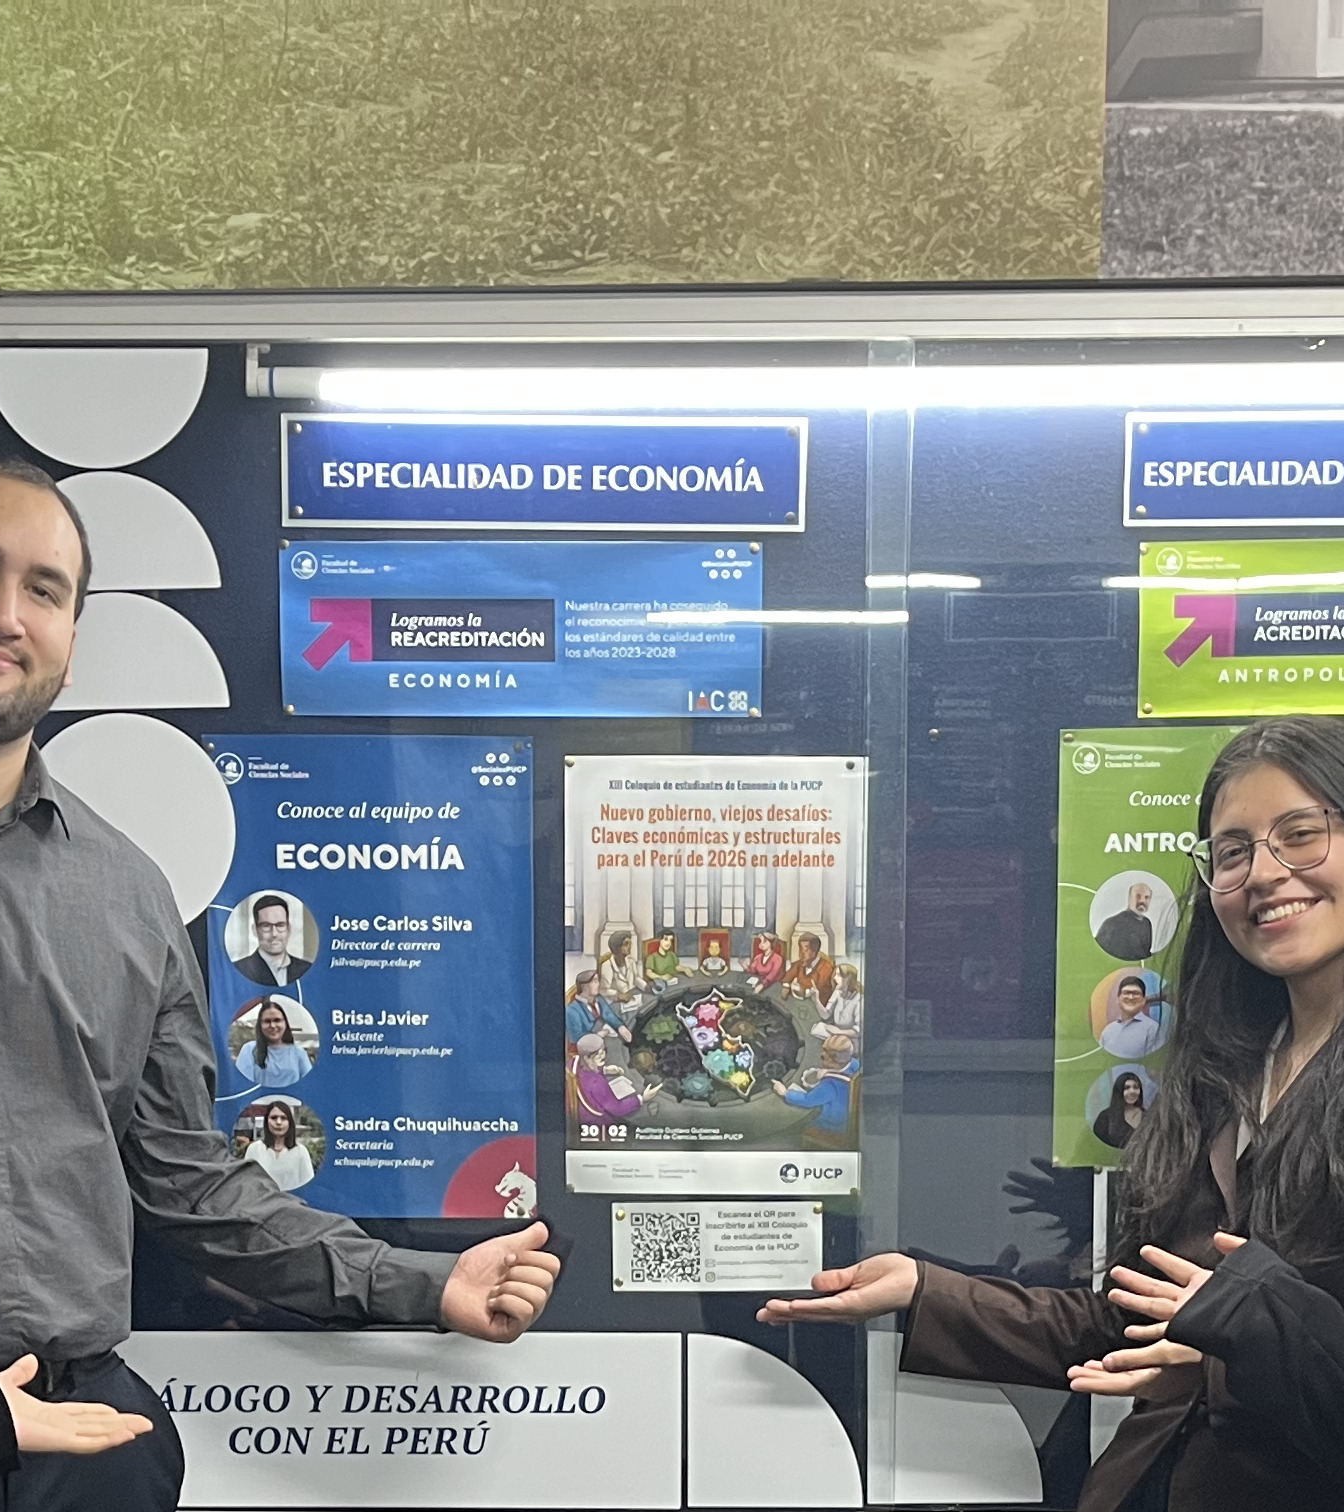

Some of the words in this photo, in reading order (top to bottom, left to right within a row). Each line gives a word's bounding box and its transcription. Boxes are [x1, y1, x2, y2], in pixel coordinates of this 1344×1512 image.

[322, 462, 534, 489] ESPECIALIDAD
[544, 465, 582, 490] DE
[592, 458, 765, 493] ECONOMÍA
[1143, 460, 1344, 486] ESPECIALIDAD
[565, 600, 610, 611] Nuestra
[612, 602, 652, 611] carrera
[654, 600, 668, 611] ha
[1255, 606, 1328, 622] Logramos
[391, 613, 464, 630] Logramos
[467, 613, 482, 627] la
[391, 628, 545, 647] REACREDITACIÓN
[565, 631, 581, 642] los
[583, 631, 644, 642] estándares
[646, 631, 660, 642] de
[663, 631, 703, 642] calidad
[706, 632, 736, 642] entre
[565, 647, 581, 658] los
[583, 647, 609, 658] años
[388, 670, 517, 688] ECONOMÍA
[1129, 791, 1191, 806] Conoce
[277, 801, 344, 819] Conoce
[349, 802, 366, 819] al
[371, 802, 433, 823] equipo
[438, 802, 461, 819] de
[600, 804, 644, 821] Nuevo
[648, 804, 716, 824] gobierno,
[720, 804, 763, 824] viejos
[767, 803, 832, 822] desafíos:
[591, 826, 639, 844] Claves
[642, 826, 728, 844] económicas
[733, 831, 740, 847] y
[744, 827, 841, 845] estructurales
[1104, 831, 1197, 853] ANTRO
[276, 837, 465, 870] ECONOMÍA
[597, 853, 629, 870] para
[633, 850, 646, 867] el
[650, 850, 682, 867] Perú
[687, 850, 704, 867] de
[708, 850, 746, 867] 2026
[751, 854, 768, 867] en
[772, 850, 835, 867] adelante
[330, 915, 369, 932] Jose
[373, 915, 428, 932] Carlos
[432, 916, 473, 932] Silva
[331, 939, 378, 951] Director
[381, 939, 395, 951] de
[397, 942, 441, 951] carrera
[332, 1010, 373, 1026] Brisa
[377, 1010, 429, 1026] Javier
[332, 1031, 384, 1042] Asistente
[334, 1116, 390, 1131] Sandra
[393, 1117, 518, 1134] Chuquihuaccha
[580, 1125, 599, 1137] 30
[608, 1125, 627, 1137] 02
[335, 1138, 394, 1151] Secretaria
[804, 1167, 843, 1179] PUCP
[161, 1378, 290, 1413] ÁLOGO
[307, 1385, 333, 1413] Y
[341, 1385, 606, 1414] DESARROLLO
[229, 1426, 313, 1455] CON
[323, 1427, 371, 1455] EL
[382, 1420, 490, 1455] PERÚ
